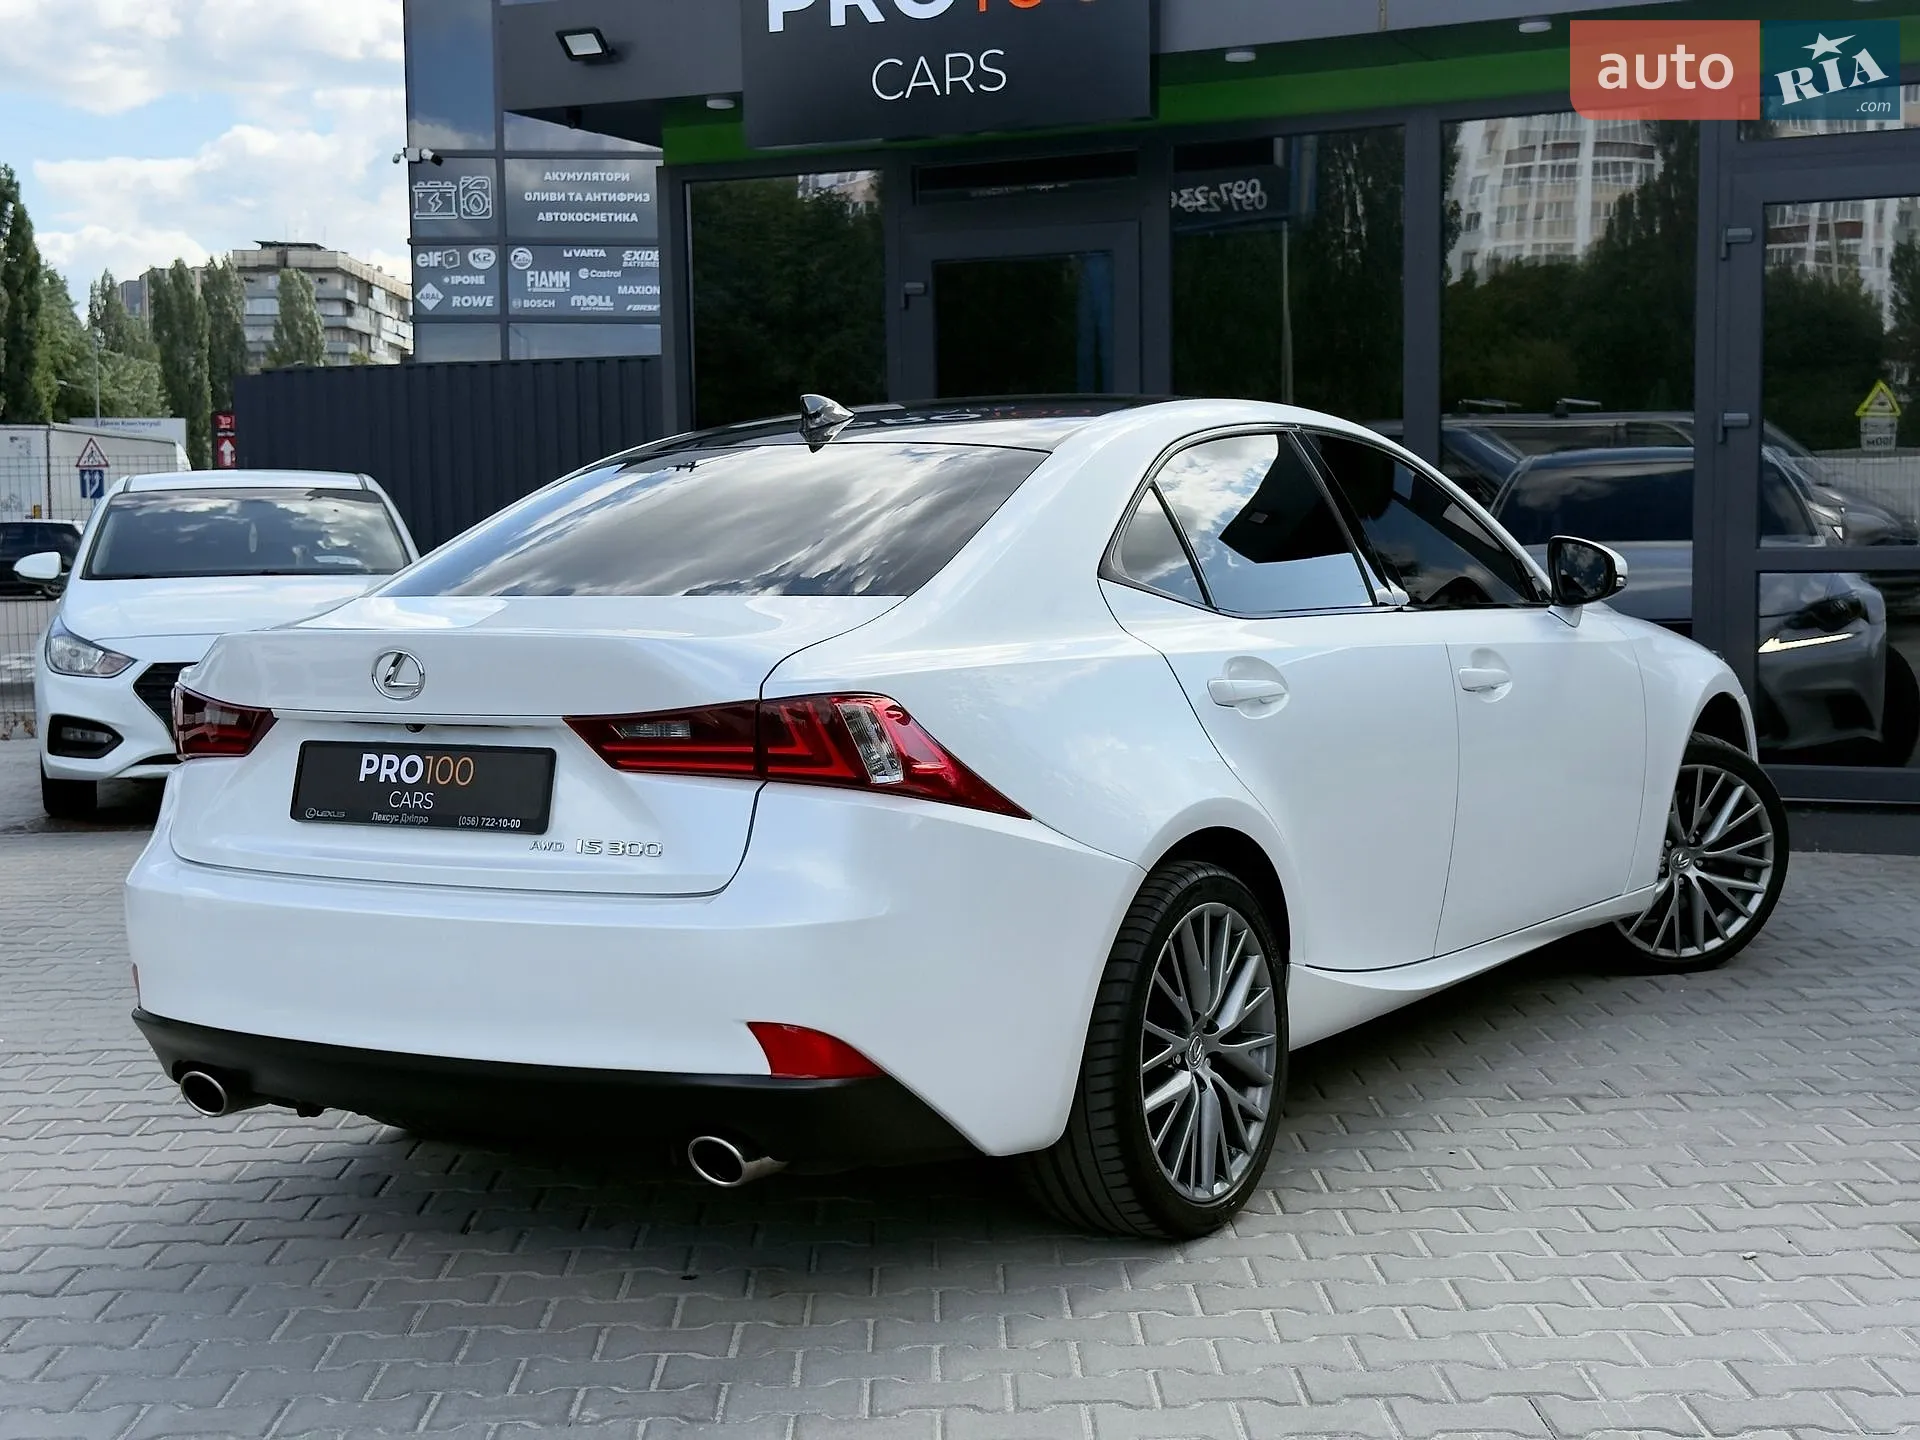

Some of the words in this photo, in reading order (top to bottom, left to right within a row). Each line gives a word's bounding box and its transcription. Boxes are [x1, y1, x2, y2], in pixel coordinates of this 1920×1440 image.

[872, 49, 1007, 100] CARS
[544, 171, 630, 182] АКУМУЛЯТОРИ
[524, 191, 565, 201] ОЛИВИ
[568, 192, 583, 202] ТА
[585, 192, 650, 203] АНТИФРИЗ
[537, 212, 638, 222] АВТОКОСМЕТИКА
[573, 248, 607, 257] VARTA
[416, 251, 442, 267] elf
[451, 275, 485, 284] IPONE
[527, 270, 570, 288] FIAMM
[590, 269, 621, 278] Castrol
[452, 295, 494, 307] ROWE
[523, 299, 555, 308] BOSCH
[359, 753, 474, 785] PRO100
[389, 791, 434, 809] CARS
[316, 810, 345, 818] LEXUS
[372, 811, 399, 823] Лексус
[401, 813, 429, 825] Дніпро
[458, 816, 479, 827] (056)
[481, 817, 521, 828] 722-10-00
[529, 840, 565, 851] AWD
[576, 839, 603, 855] IS
[607, 840, 664, 858] 300
